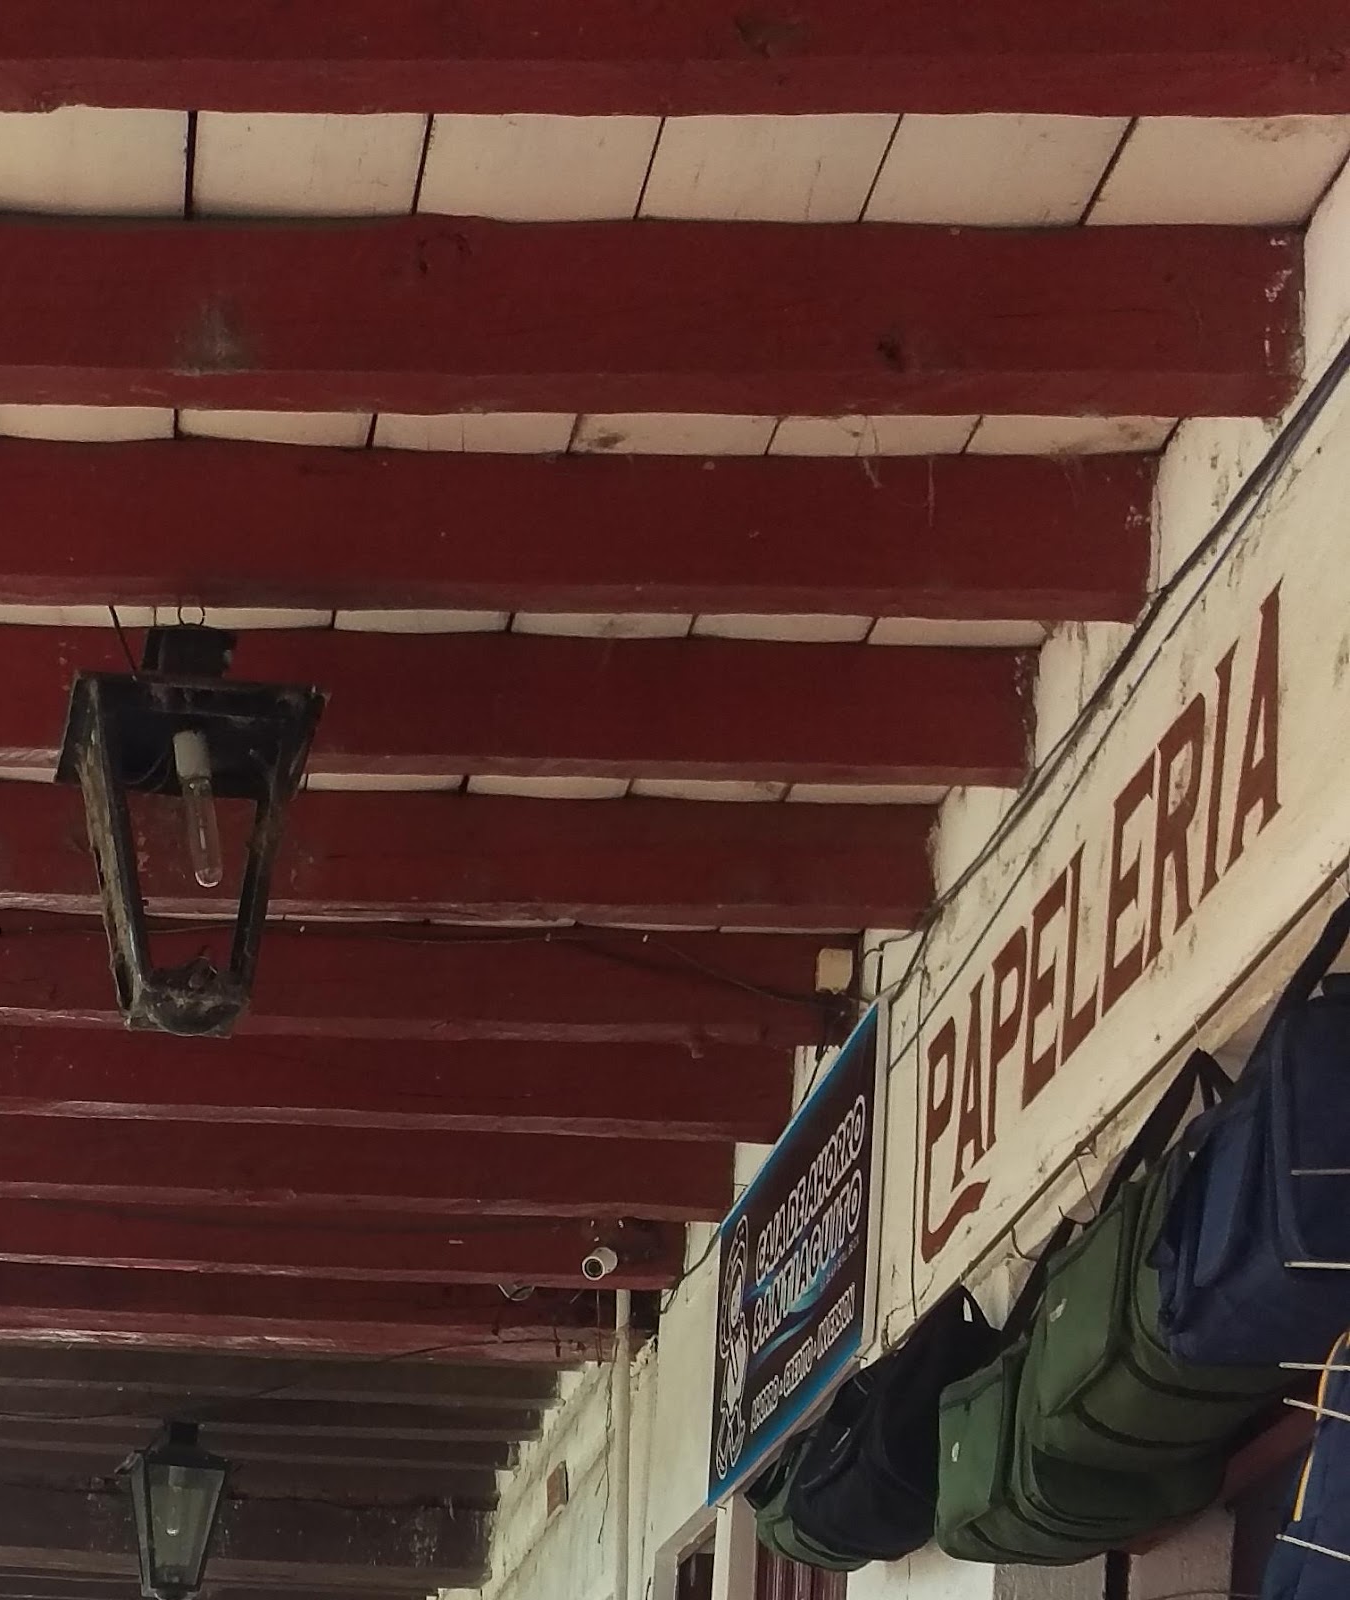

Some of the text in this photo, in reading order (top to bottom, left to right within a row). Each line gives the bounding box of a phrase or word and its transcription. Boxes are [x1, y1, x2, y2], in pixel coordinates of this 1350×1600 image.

[922, 577, 1284, 1263] PAPELERIA
[751, 1168, 863, 1355] SANTIAGUITO
[756, 1203, 786, 1286] CAJA
[787, 1174, 807, 1249] DE
[804, 1094, 866, 1225] AHORRO
